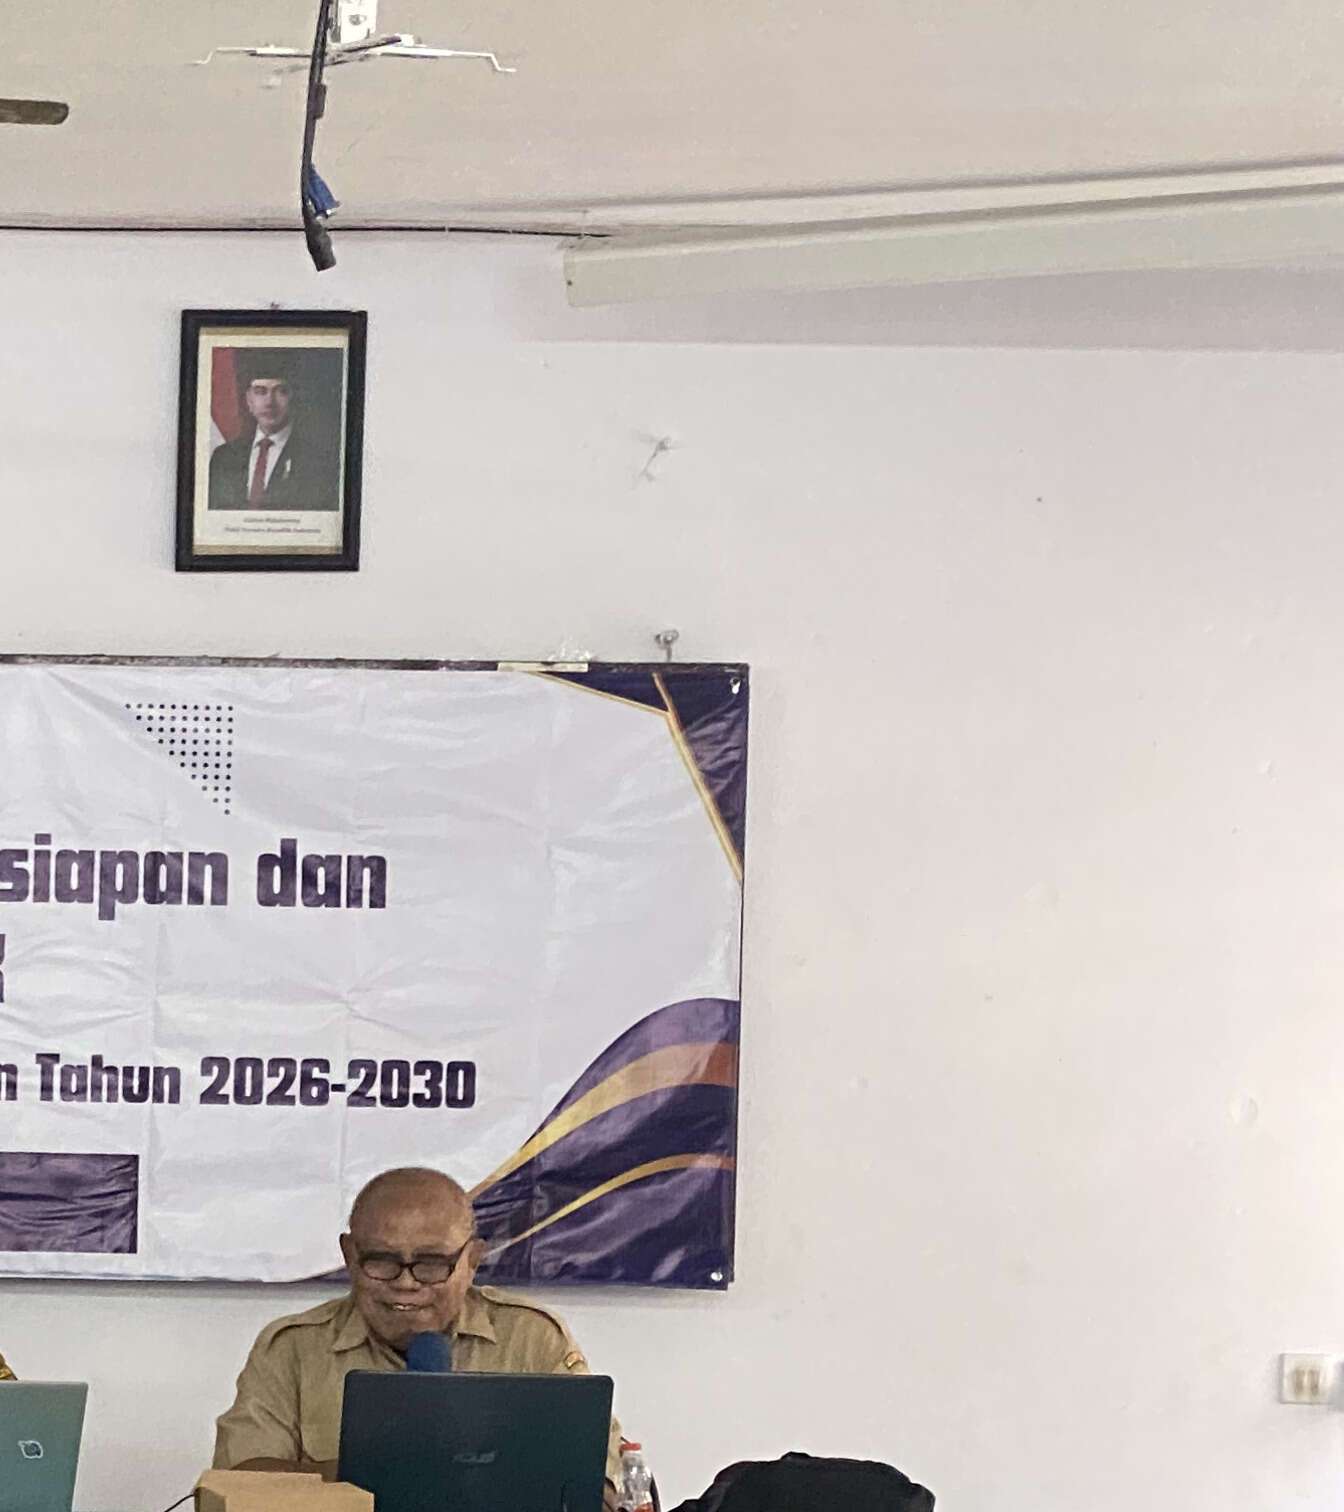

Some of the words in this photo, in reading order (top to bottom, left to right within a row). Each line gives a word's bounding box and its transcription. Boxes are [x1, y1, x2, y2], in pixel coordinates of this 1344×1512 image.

[256, 838, 387, 909] dan
[35, 1052, 181, 1105] Tahun
[199, 1056, 477, 1109] 2026-2030
